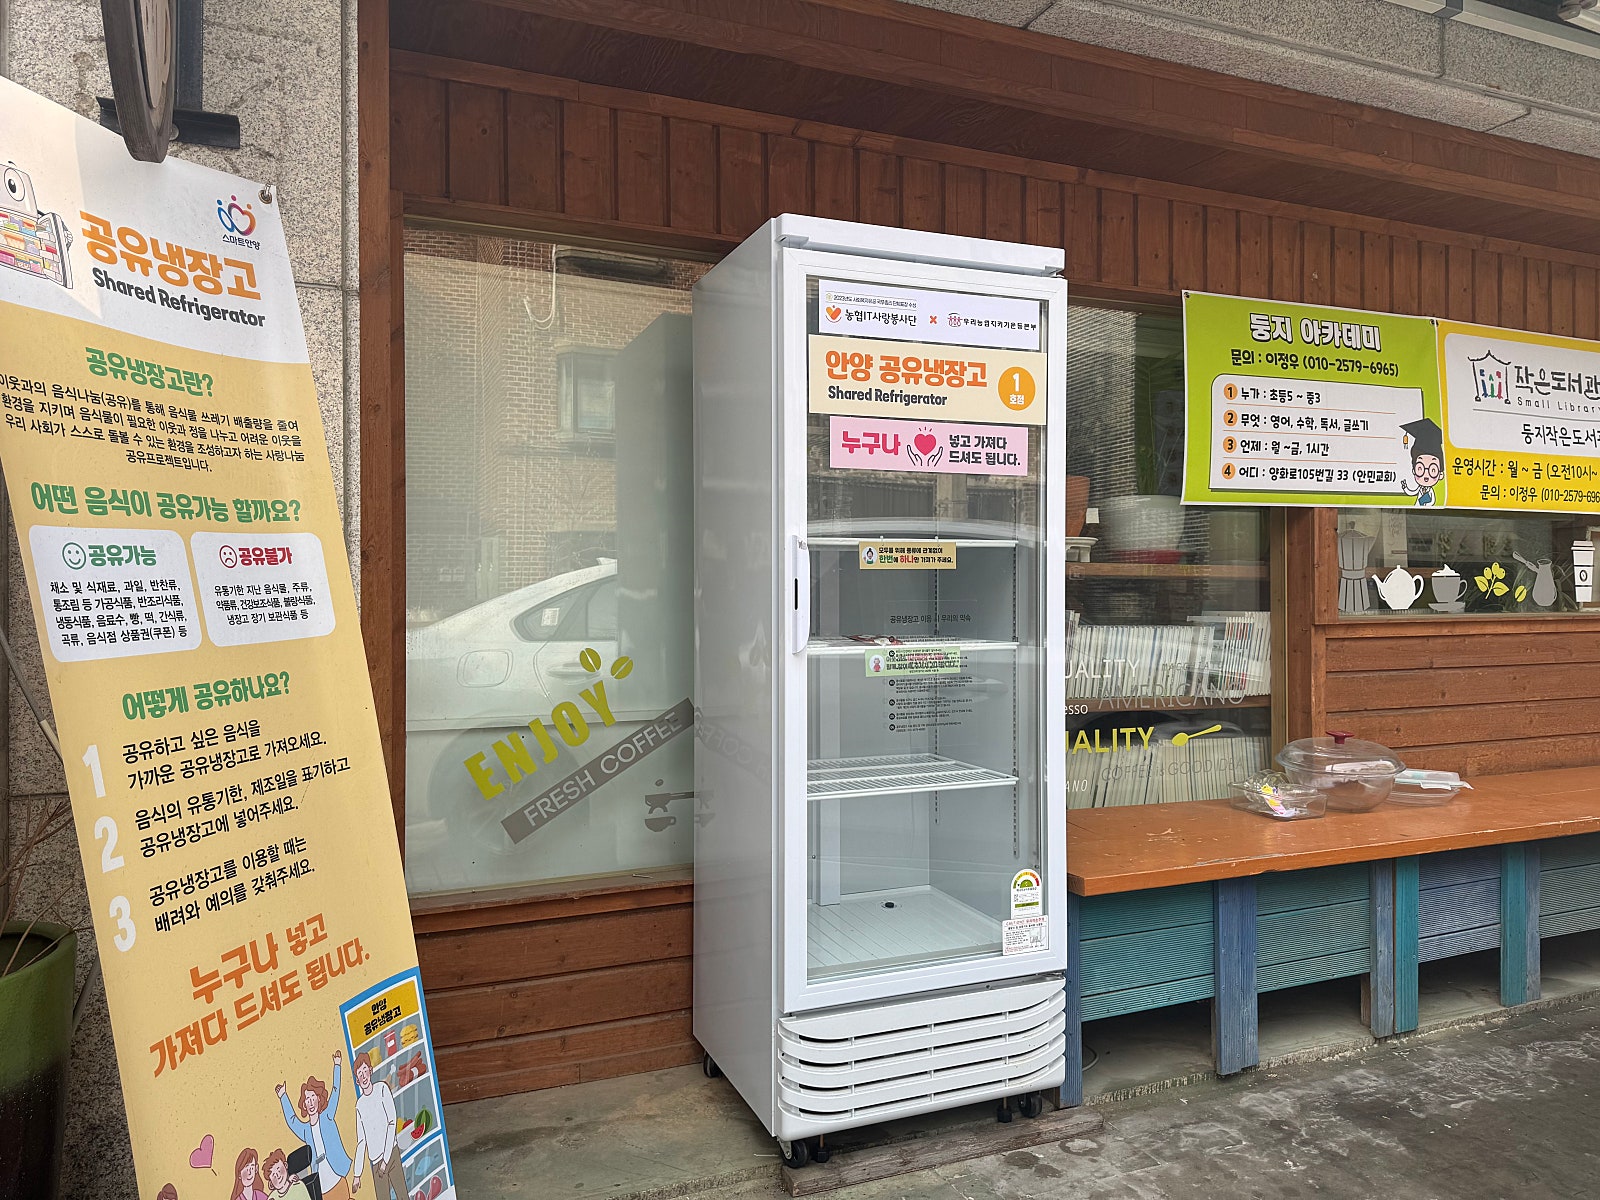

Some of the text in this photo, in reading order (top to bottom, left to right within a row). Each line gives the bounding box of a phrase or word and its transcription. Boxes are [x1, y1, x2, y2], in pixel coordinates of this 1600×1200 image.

[80, 211, 261, 300] 공유냉장고
[222, 234, 261, 250] 스마트안양
[92, 267, 266, 328] Shared Refrigerator
[845, 309, 917, 327] 농협IT사랑봉사단
[1249, 313, 1383, 352] 둥지 아카데미
[85, 346, 214, 397] 공유냉장고란?
[825, 350, 988, 389] 안양 공유냉장고
[1231, 348, 1399, 378] 문의 이정우 (010-2579-6965)
[828, 386, 948, 407] Shared Refrigerator
[1012, 372, 1021, 393] 1
[1241, 386, 1321, 405] 누가 초등5 중3
[1514, 365, 1600, 401] 작은도서관
[0, 373, 299, 432] 이웃과의 음식나눔(공유)를 통해 음식물 쓰레기 배출량을 줄여
[1009, 393, 1025, 406] 호점
[1517, 396, 1550, 409] Small
[1, 392, 302, 447] 환경을 지키며 음식물이 필요한 이웃과 정을 나누고 어려운 이웃을
[1241, 413, 1369, 432] 무엇 영어, 수학, 독서, 글쓰기
[5, 413, 305, 462] 우리 사회가 스스로 돌볼 수 있는 환경을 조성하고자 하는 사랑나눔
[841, 430, 1008, 456] 누구나 넣고 가져다
[1240, 439, 1330, 457] 언제 월 1시간
[125, 449, 213, 473] 공유프로젝트입니다.
[948, 452, 1021, 466] 드셔도 됩니다.
[1452, 457, 1497, 477] 운영시간
[1507, 460, 1519, 479] 월
[1532, 462, 1543, 480] 금
[1239, 466, 1397, 484] 어디 양화로105번길 33 (안민교회)
[30, 480, 302, 524] 어떤 음식이 공유가능 할까요?
[1480, 485, 1538, 502] 문의 이정우
[88, 544, 157, 567] 공유가능
[238, 547, 293, 567] 공유불가
[50, 579, 181, 595] 채소 및 식재료, 과일, 반찬류,
[214, 581, 313, 597] 유통기한 지난 음식물, 주류,
[53, 594, 184, 613] 통조림 등 가공식품, 반조리식품,
[239, 597, 283, 611] 건강보조식품,
[283, 594, 316, 608] 불량식품,
[55, 610, 187, 630] 냉동식품, 음료수, 빵, 떡, 간식류,
[226, 608, 309, 627] 냉장고 장기 보관식품 등
[61, 625, 188, 647] 곡류, 음식점 상품권(쿠폰) 등
[121, 670, 291, 721] 어떻게 공유하나요?
[1098, 683, 1246, 710] AMERICANO
[122, 719, 261, 765] 공유하고 싶은 음식을
[463, 680, 617, 801] ENJOY
[82, 744, 107, 799] 1
[128, 731, 328, 791] 가까운 공유냉장고로 가져오세요.
[523, 769, 596, 827] FRESH
[600, 711, 683, 774] COFFEE
[135, 756, 351, 831] 음식의 유통기한, 제조일을 표기하고
[140, 795, 299, 858] 공유냉장고에 넣어주세요.
[94, 815, 125, 874] 2
[149, 836, 307, 907] 공유냉장고를 이용할 때는
[154, 858, 316, 933] 배려와 예의를 갖춰주세요.
[109, 895, 136, 952] 3
[189, 913, 328, 1004] 누구나 넣고
[149, 937, 370, 1079] 가져다 드셔도 됩니다.
[364, 1005, 402, 1036] 공유냉장고
[371, 998, 387, 1016] 안양
